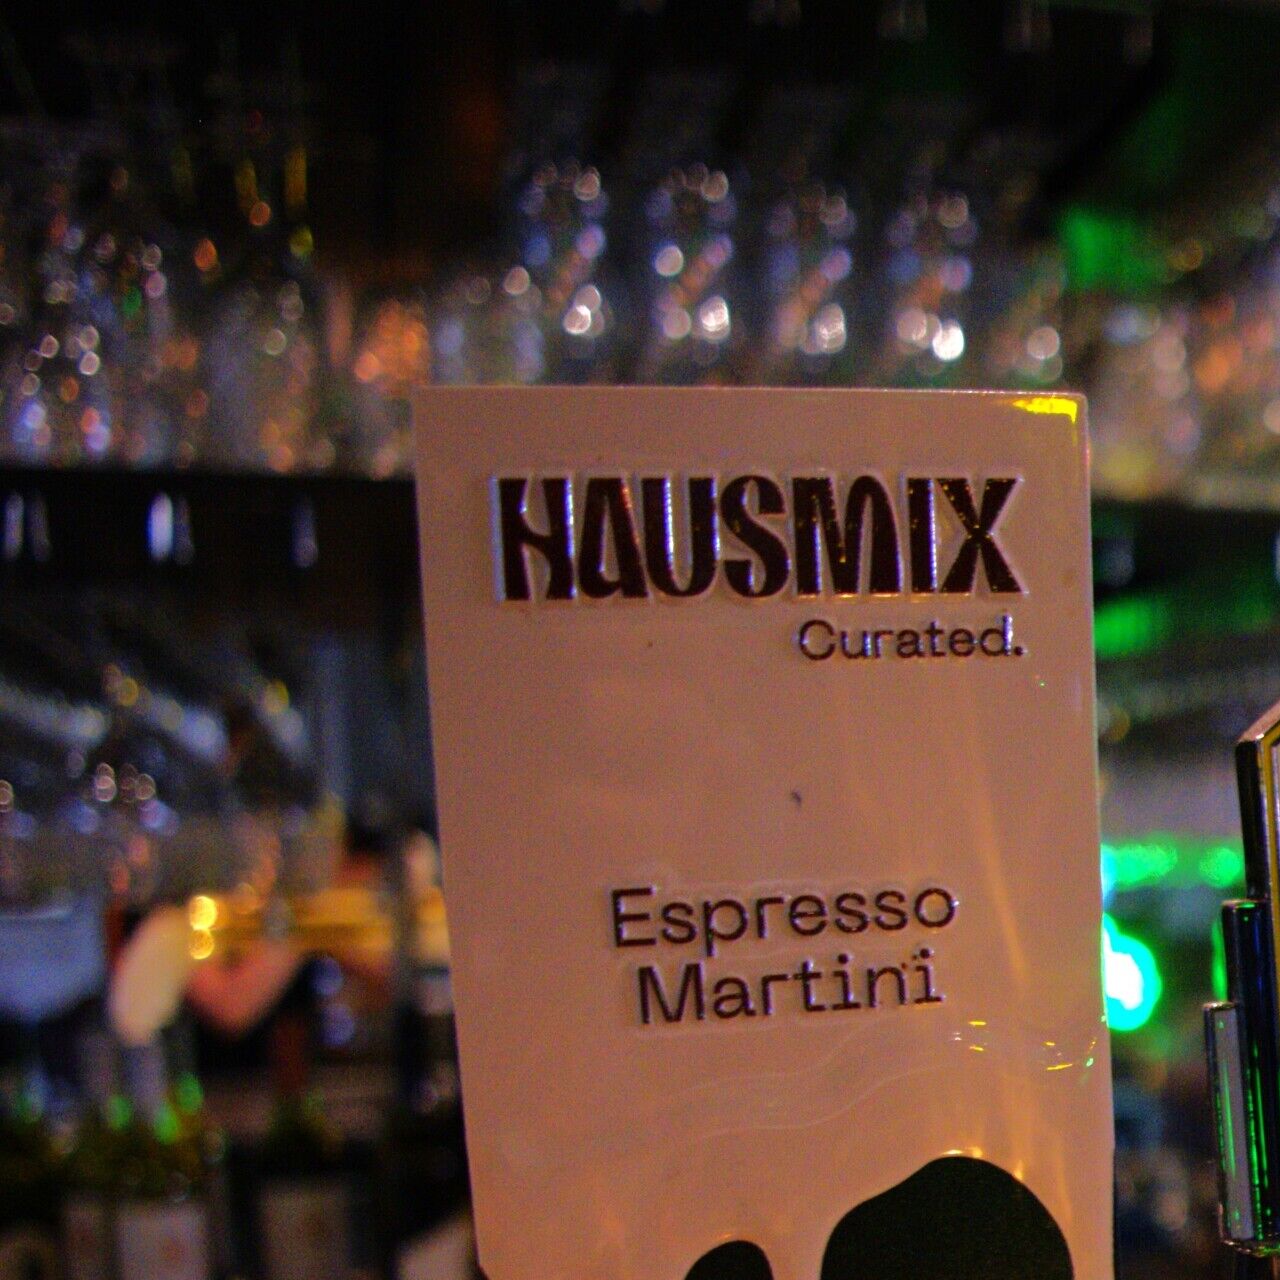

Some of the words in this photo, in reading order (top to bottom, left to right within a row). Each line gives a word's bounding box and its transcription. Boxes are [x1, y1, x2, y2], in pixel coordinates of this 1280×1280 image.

[490, 472, 1028, 600] HAUSMIX
[797, 614, 1026, 662] Curated.
[608, 884, 960, 954] Espresso
[636, 948, 946, 1026] Martini
